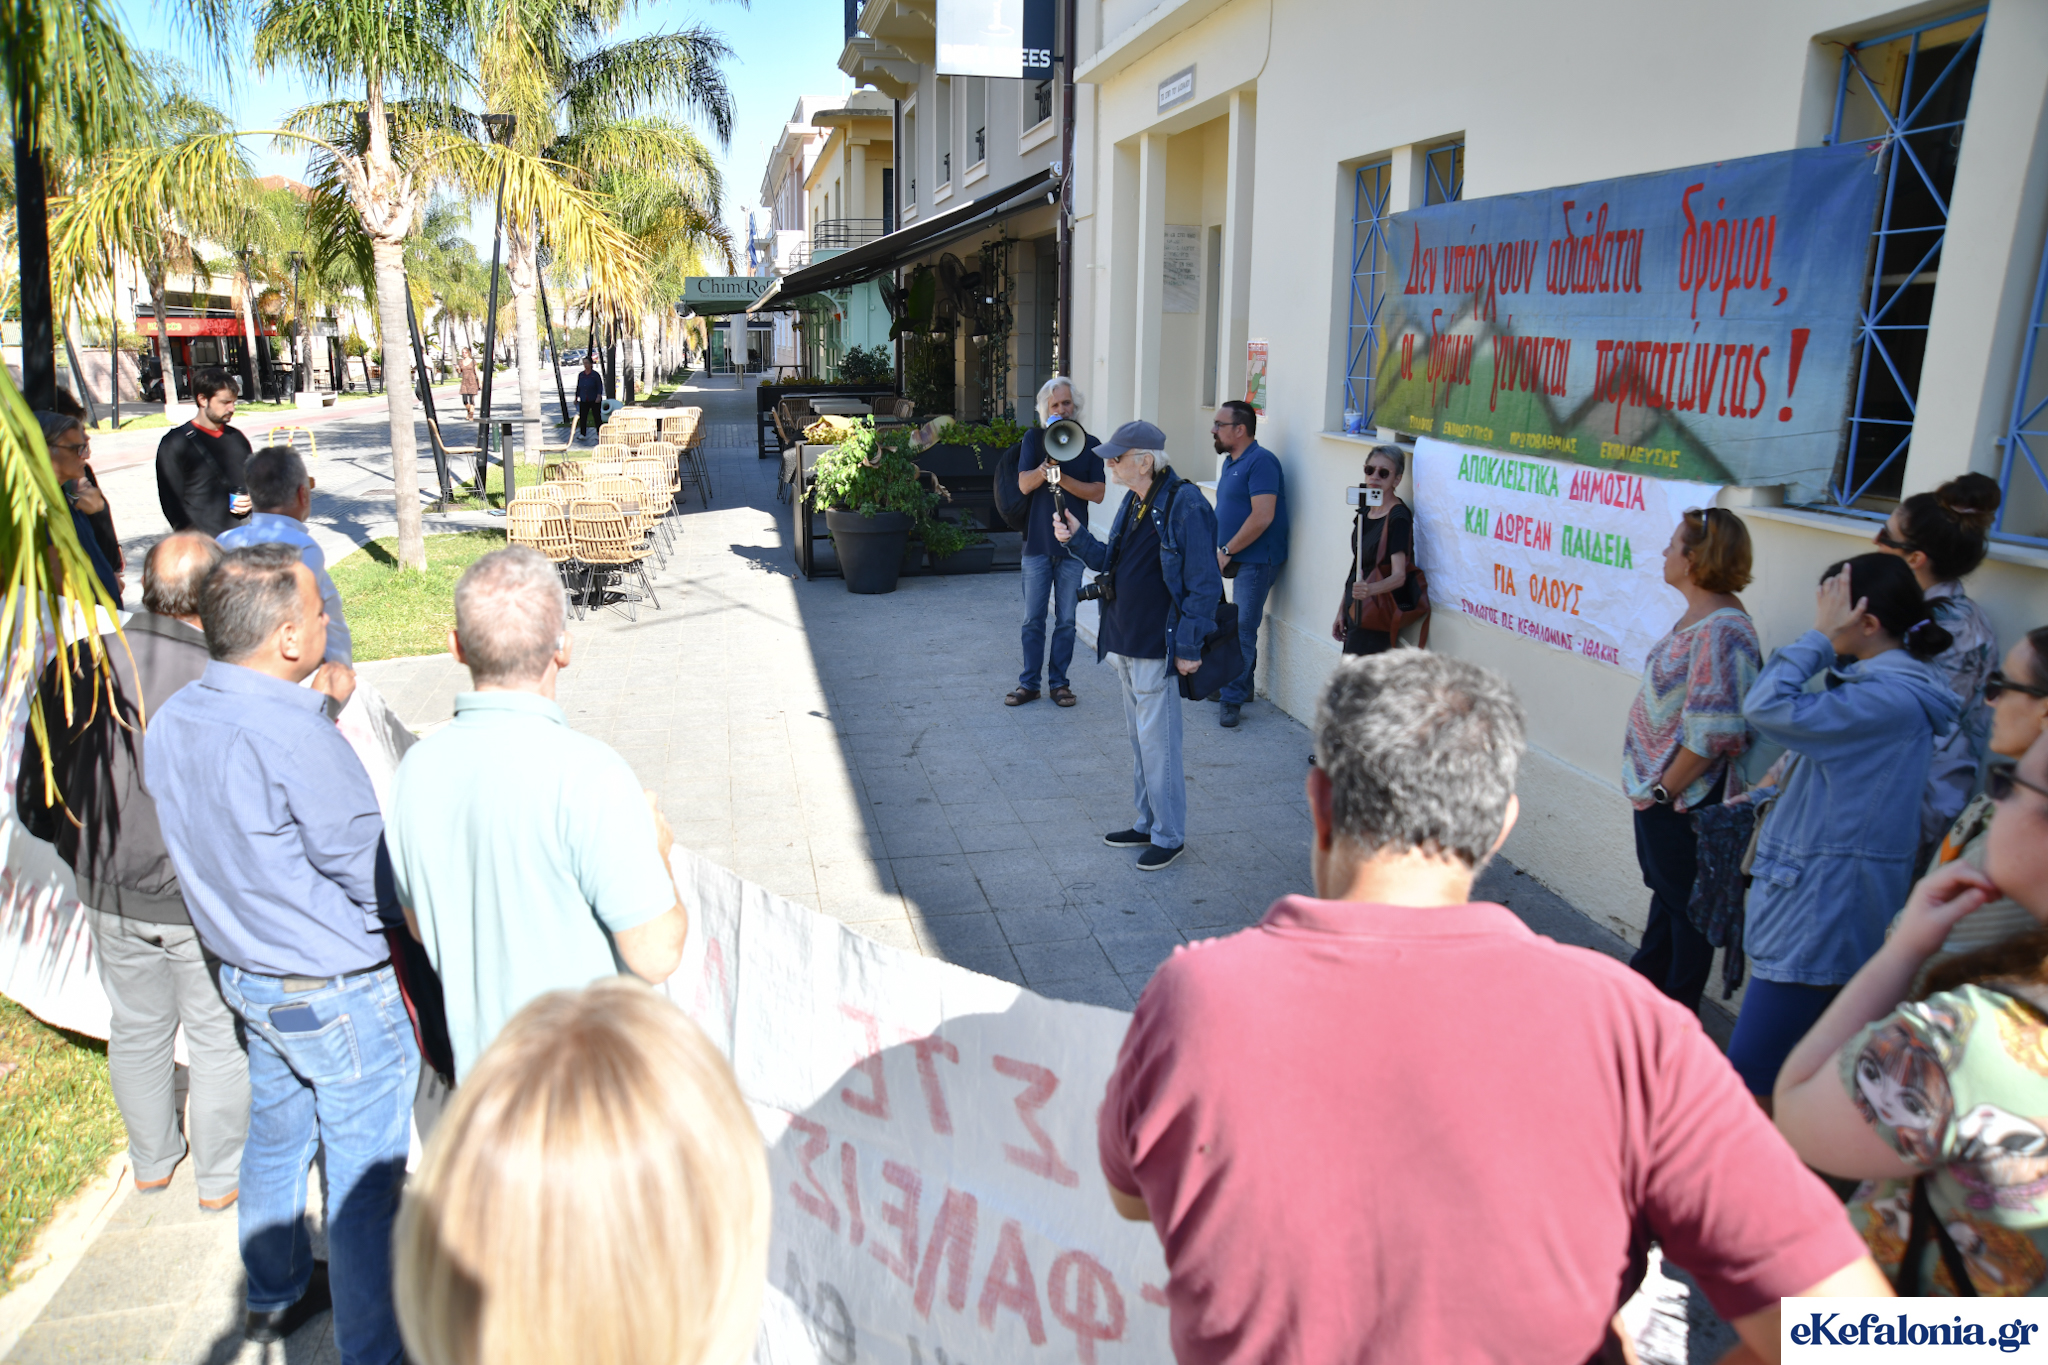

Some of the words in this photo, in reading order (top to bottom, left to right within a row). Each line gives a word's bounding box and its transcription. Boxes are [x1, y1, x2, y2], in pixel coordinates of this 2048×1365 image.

[1404, 221, 1437, 295] Δεν
[1444, 223, 1539, 324] υπάρχουν
[1546, 200, 1645, 296] αδιάβατοι
[1679, 182, 1788, 320] δρόμοι,
[1401, 333, 1415, 381] οι
[1427, 308, 1474, 409] δρόμοι
[1490, 314, 1572, 413] γίνονται
[1509, 431, 1578, 454] ΠΡΩΤΟΒΑΘΜΙΑΣ
[1600, 441, 1681, 468] ΕΚΠΑΙΔΕΥΣΗΣ
[1457, 453, 1560, 497] ΑΠΟΚΛΕΙΣΤΙΚΑ
[1569, 469, 1646, 511] ΔΗΜΟΣΙΑ
[1465, 505, 1489, 536] ΚΑΙ
[1494, 511, 1552, 552] ΔΩΡΕΑΝ
[1561, 524, 1633, 570] ΠΑΙΔΕΙΑ
[1494, 563, 1516, 597] ΓΙΑ
[1529, 573, 1583, 616] ΟΛΟΥΣ
[1518, 616, 1573, 650] ΚΕΦΑΛΟΝΙΑΣ
